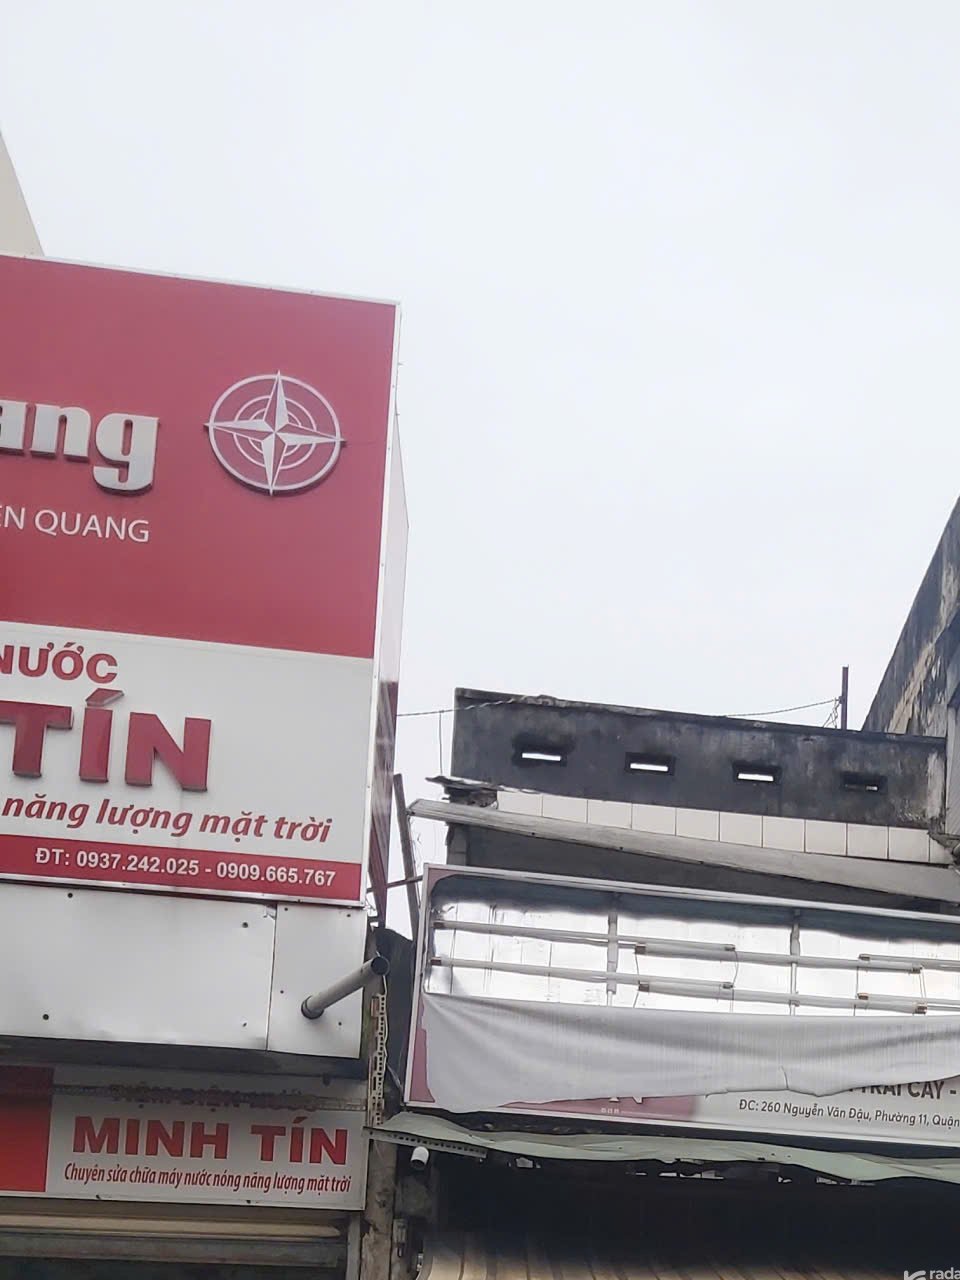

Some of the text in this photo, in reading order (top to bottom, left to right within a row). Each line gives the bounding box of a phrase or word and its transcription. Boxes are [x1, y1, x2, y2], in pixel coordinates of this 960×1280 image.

[34, 508, 150, 543] QUANG
[0, 687, 212, 792] TÍN
[1, 793, 333, 843] năng lượng mặt trời
[35, 847, 70, 866] ĐT:
[76, 849, 200, 876] 0937.242.025
[216, 862, 336, 887] 0909.665.767
[739, 1099, 759, 1112] ĐC:
[761, 1101, 781, 1113] 260
[783, 1101, 824, 1118] Nguyễn
[827, 1105, 846, 1119] Văn
[848, 1107, 872, 1122] Đậu,
[875, 1110, 916, 1126] Phường
[918, 1113, 930, 1127] 11,
[932, 1114, 960, 1130] Quận
[73, 1115, 348, 1165] MINH TÍN
[64, 1162, 352, 1195] Chuyên sửa chữa máy nước nóng năng lượng mặt trời
